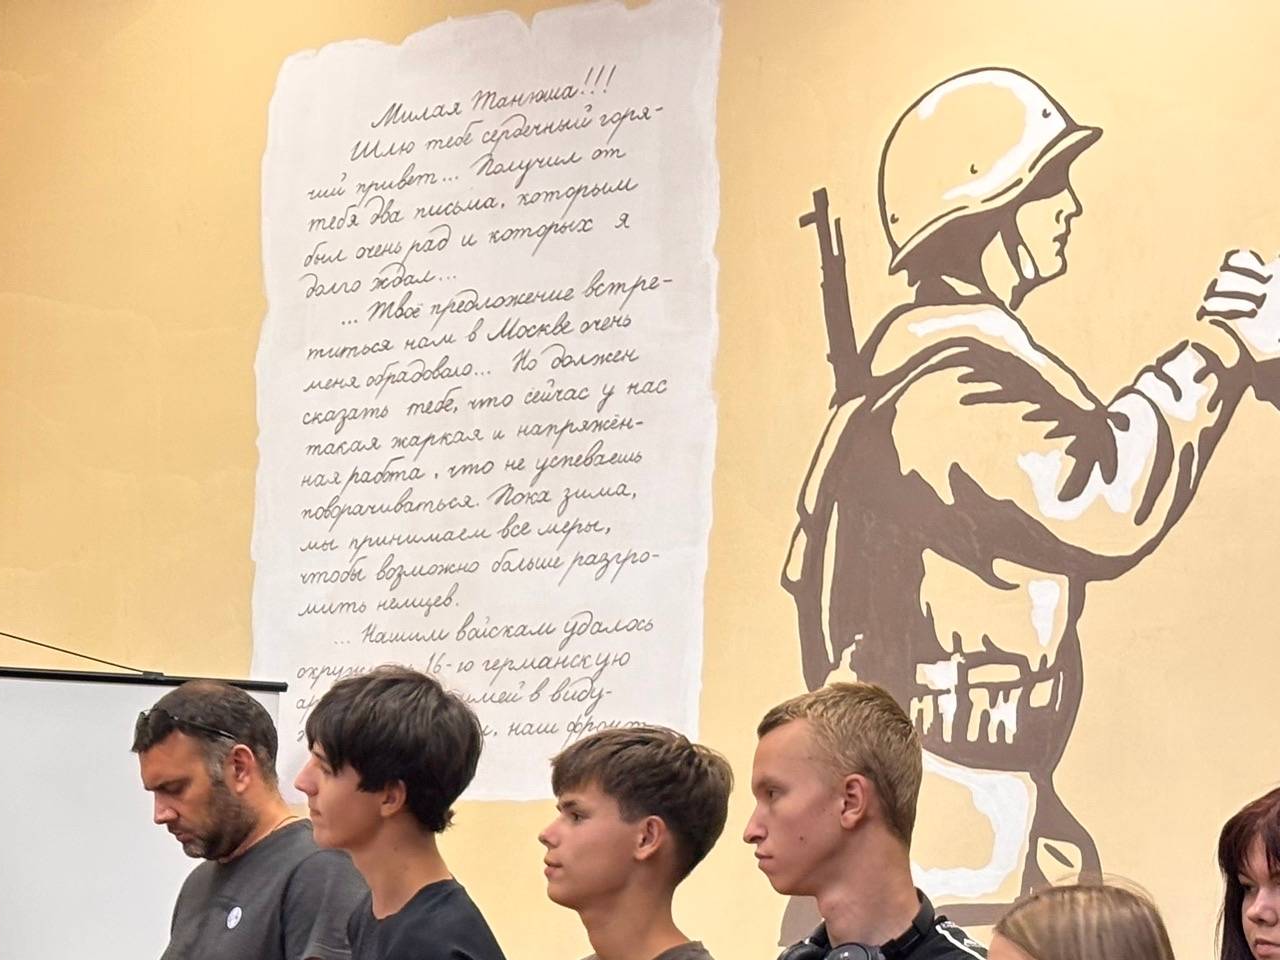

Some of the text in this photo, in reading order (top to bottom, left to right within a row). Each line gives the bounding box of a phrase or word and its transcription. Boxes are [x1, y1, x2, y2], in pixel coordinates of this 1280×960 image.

[371, 64, 617, 129] Милая Танюша!!!
[350, 104, 664, 162] Шлю тебе сердечный горя-
[307, 173, 346, 201] чий
[470, 152, 582, 192] Получил
[591, 145, 627, 160] от
[307, 204, 359, 232] тебя
[364, 194, 402, 226] два
[517, 178, 638, 220] которым
[303, 212, 631, 269] был очень рад и которых я
[298, 274, 361, 299] долго
[430, 288, 574, 332] предложение
[585, 269, 673, 310] встре-
[306, 310, 632, 361] титься нам в Москве очень
[303, 376, 360, 394] меня
[511, 347, 538, 372] Но
[542, 344, 639, 368] должен
[302, 379, 668, 434] сказать тебе, что сейчас у нас
[301, 469, 341, 488] ная
[448, 459, 495, 479] что
[504, 454, 526, 471] не
[530, 439, 642, 484] успеваешь
[304, 430, 381, 457] такая
[390, 428, 480, 461] жаркая
[492, 428, 504, 443] и
[487, 483, 551, 506] Пока
[557, 483, 637, 518] зима,
[299, 512, 612, 563] мы принимаем все меры,
[299, 555, 368, 585] чтобы
[376, 553, 479, 592] возможно
[558, 548, 660, 588] разгро-
[297, 598, 367, 617] мить
[360, 622, 448, 645] Нашим
[558, 610, 655, 652] удалось
[480, 651, 630, 683] германскую
[529, 677, 541, 702] в
[549, 676, 611, 716] виду-
[507, 720, 559, 738] наш
